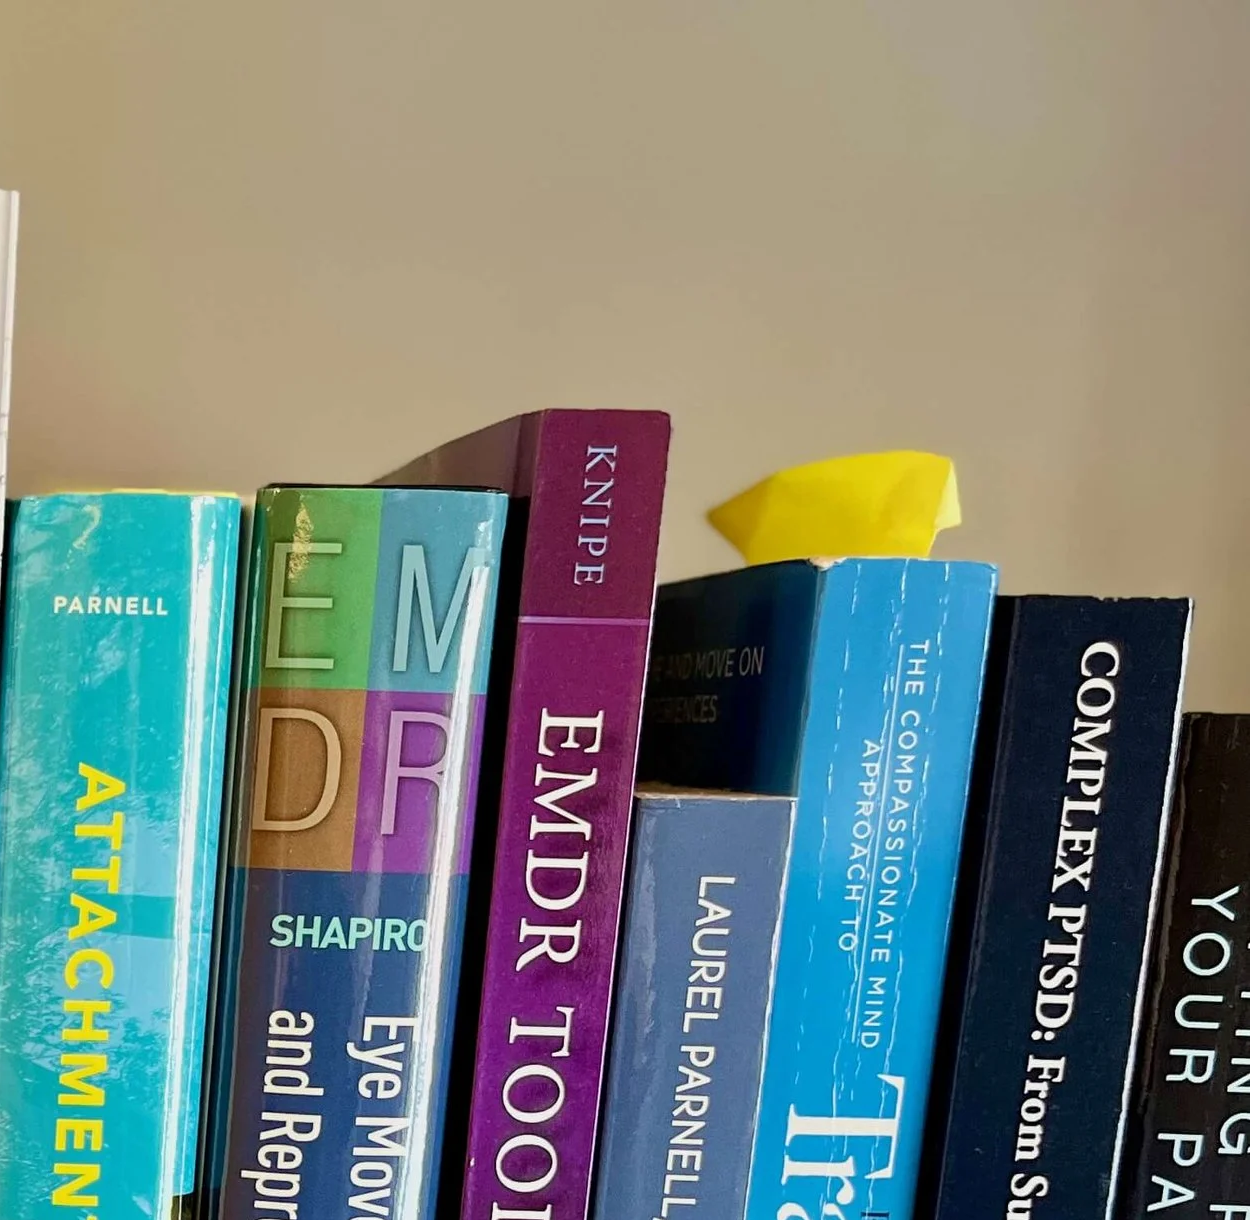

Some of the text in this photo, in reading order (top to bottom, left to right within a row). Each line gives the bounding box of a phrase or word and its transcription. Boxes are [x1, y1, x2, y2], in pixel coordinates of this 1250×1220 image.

[574, 445, 617, 585] KNIPE
[54, 596, 168, 615] PARNELL
[739, 646, 764, 676] ON
[1052, 642, 1119, 892] COMPLEX
[516, 708, 603, 971] EMDR
[838, 739, 883, 951] APPROACH TO
[861, 640, 929, 1047] THE COMPASSIONATE MIND
[270, 915, 430, 952] SHAPIRO
[683, 877, 735, 1032] LAUREL
[1031, 903, 1086, 1040] PTSD:
[1166, 886, 1239, 1083] YOUR
[264, 1011, 324, 1095] and
[347, 1013, 422, 1100] Eye
[1015, 1055, 1065, 1161] From
